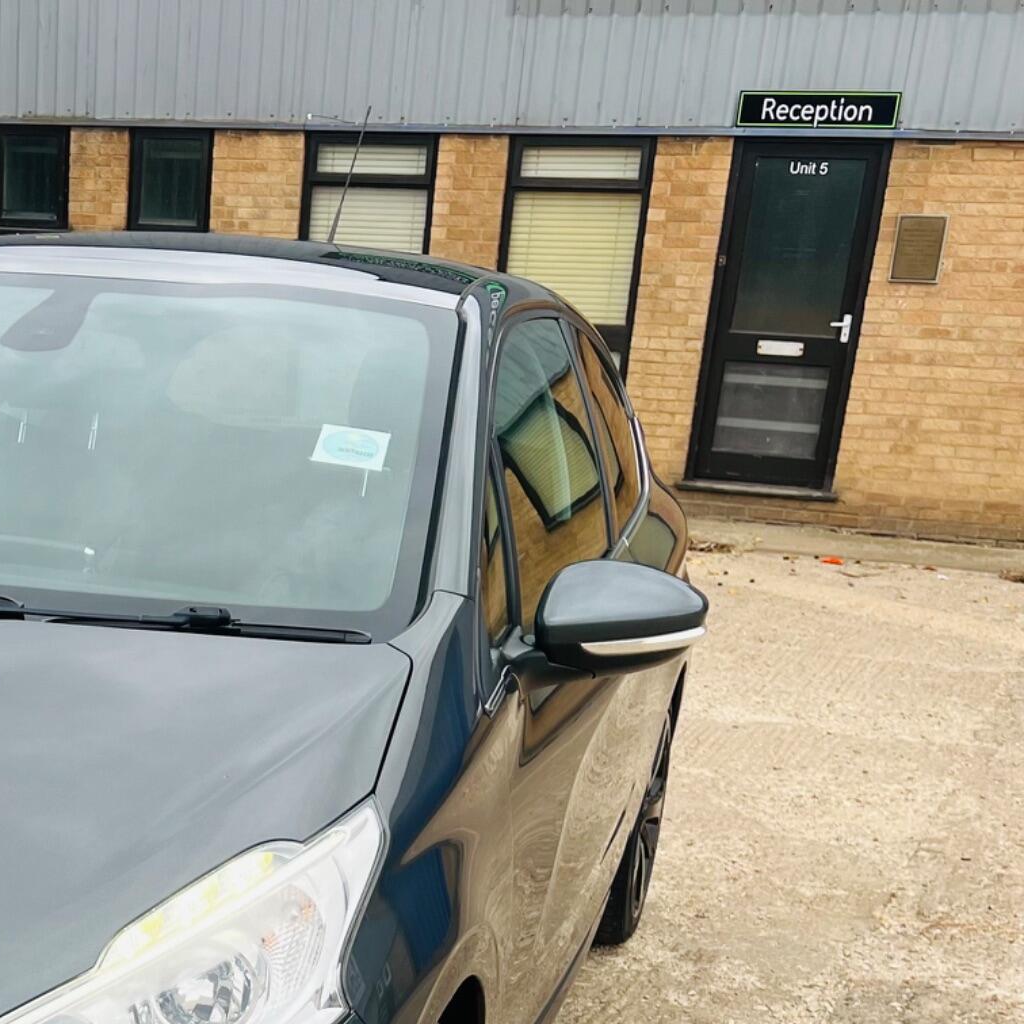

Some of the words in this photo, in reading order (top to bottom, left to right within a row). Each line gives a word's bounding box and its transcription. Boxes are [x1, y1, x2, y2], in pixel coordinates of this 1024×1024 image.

[761, 97, 873, 128] Reception
[789, 161, 817, 175] Unit
[818, 161, 829, 176] 5
